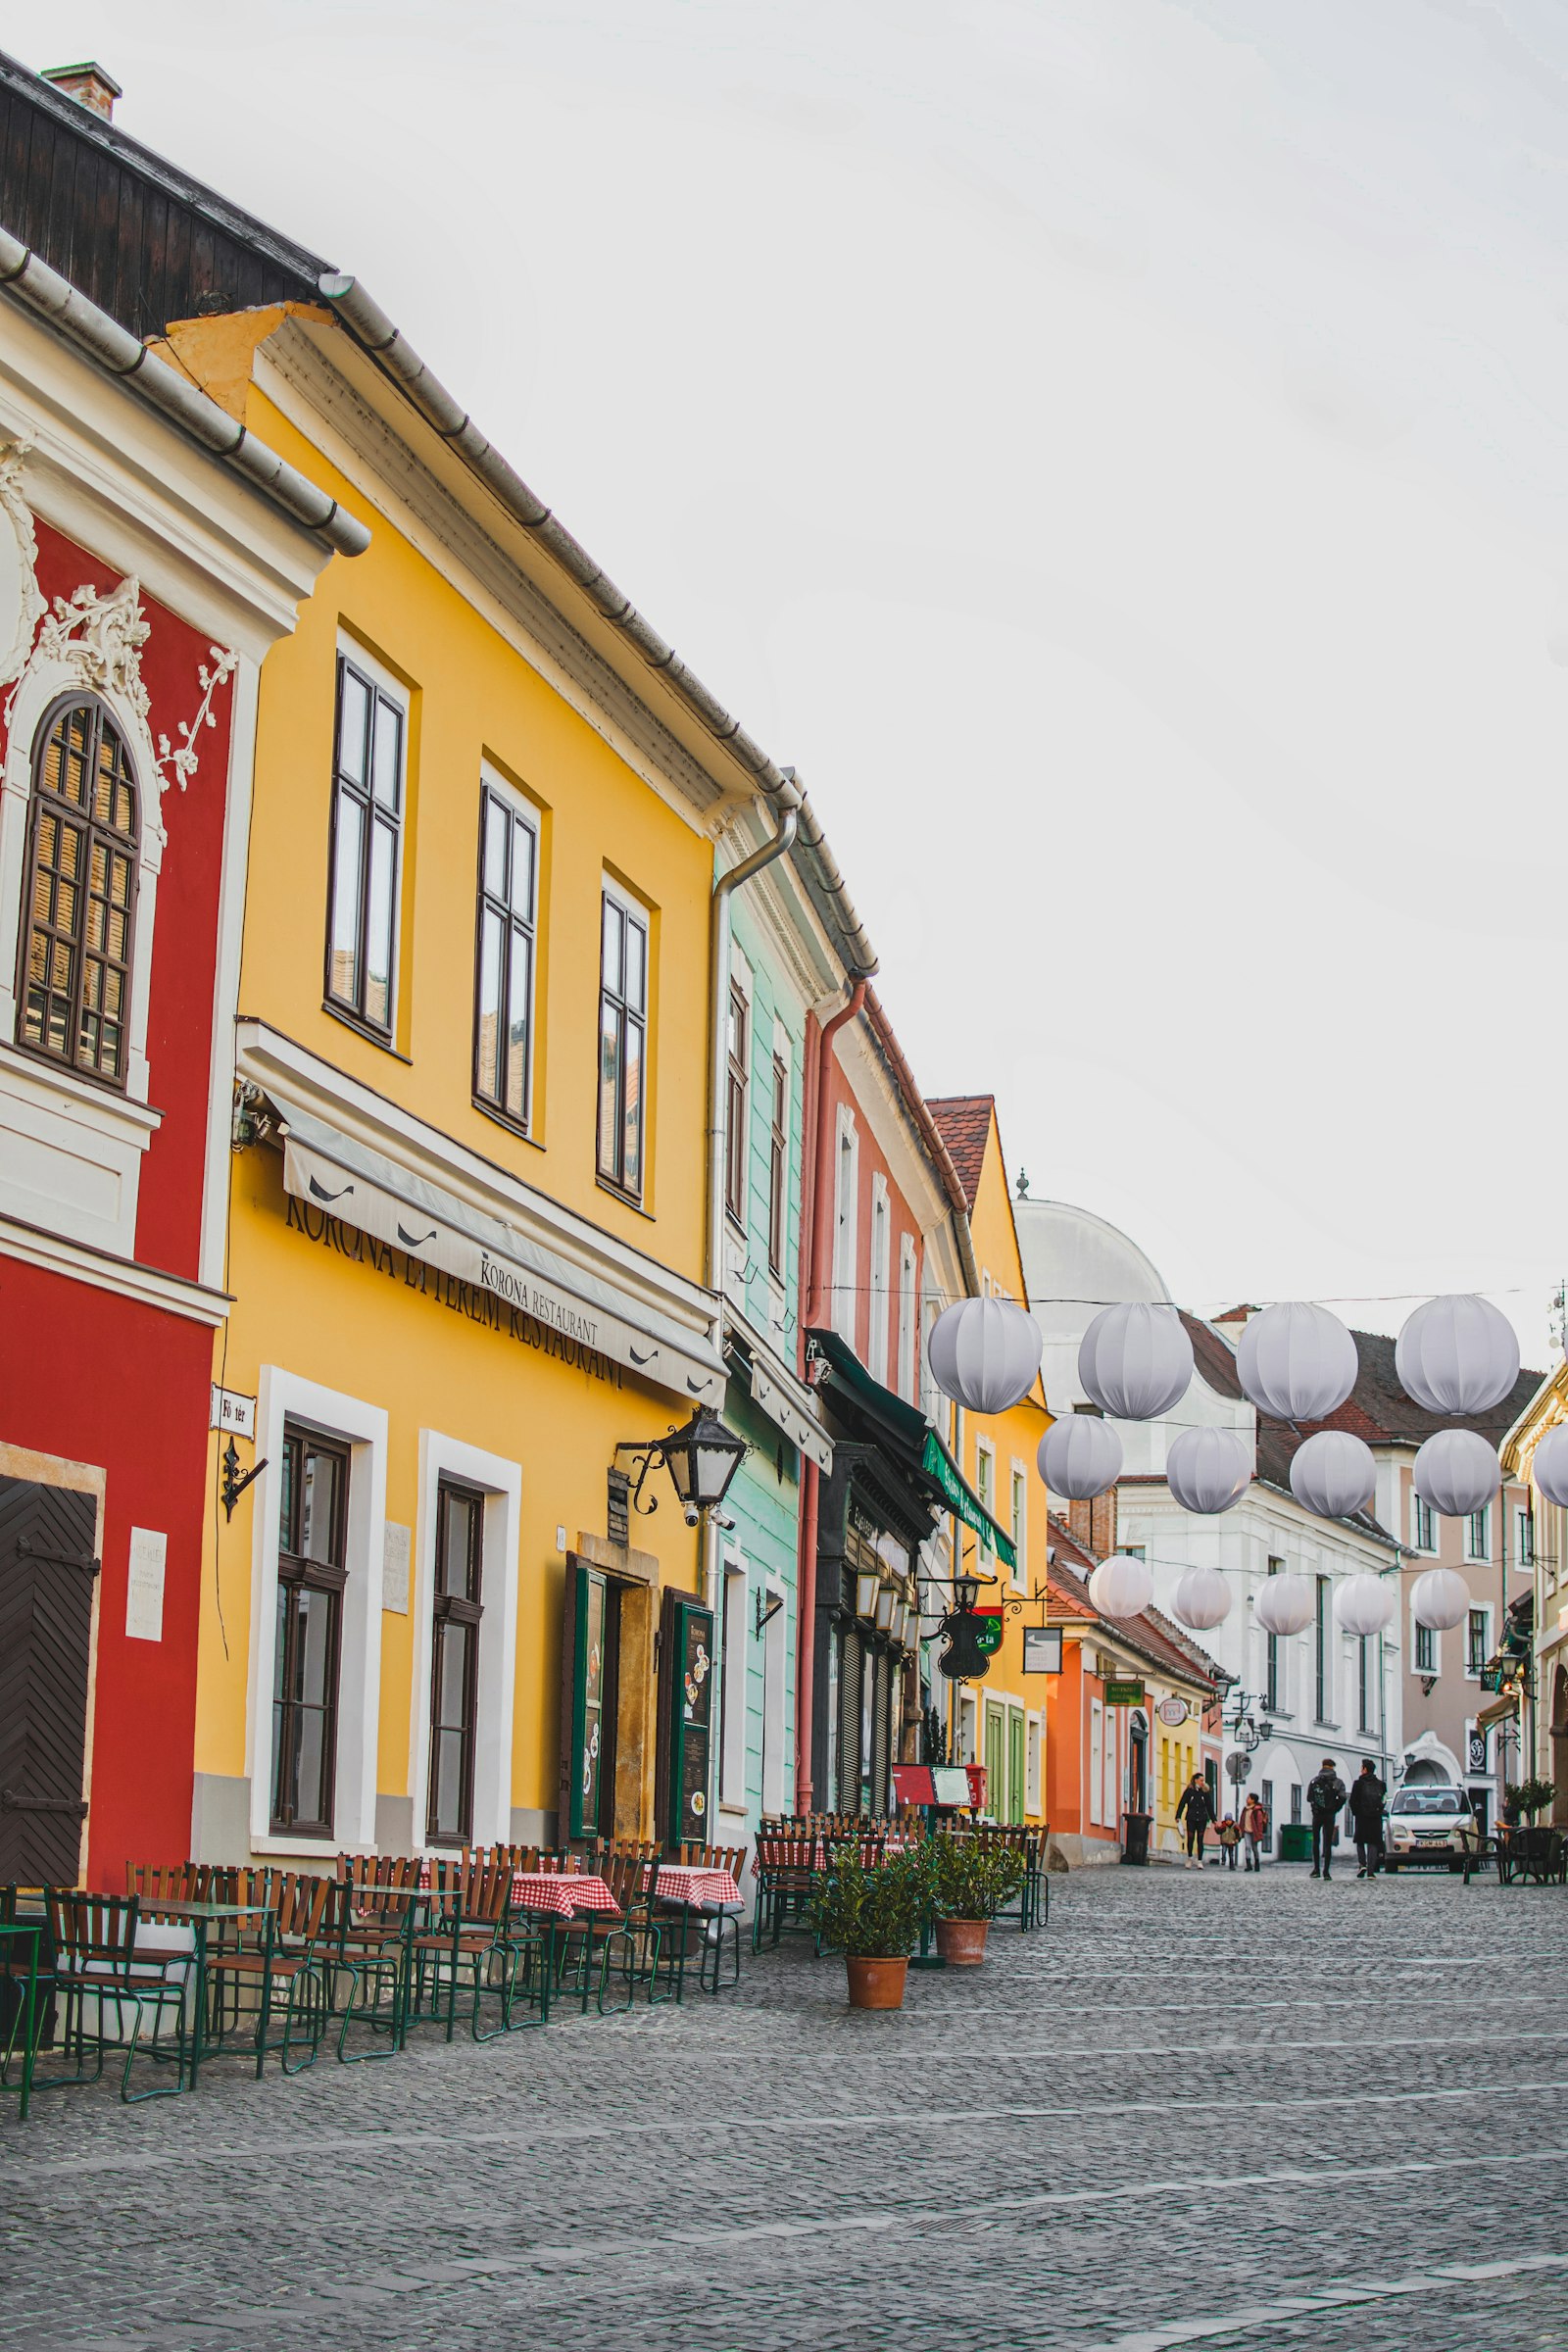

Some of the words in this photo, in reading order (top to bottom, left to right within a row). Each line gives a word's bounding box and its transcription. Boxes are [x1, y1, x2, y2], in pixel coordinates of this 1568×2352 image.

[285, 1194, 396, 1278] KORONA
[480, 1260, 529, 1307] KORONA
[532, 1290, 598, 1346] RESTAURANT
